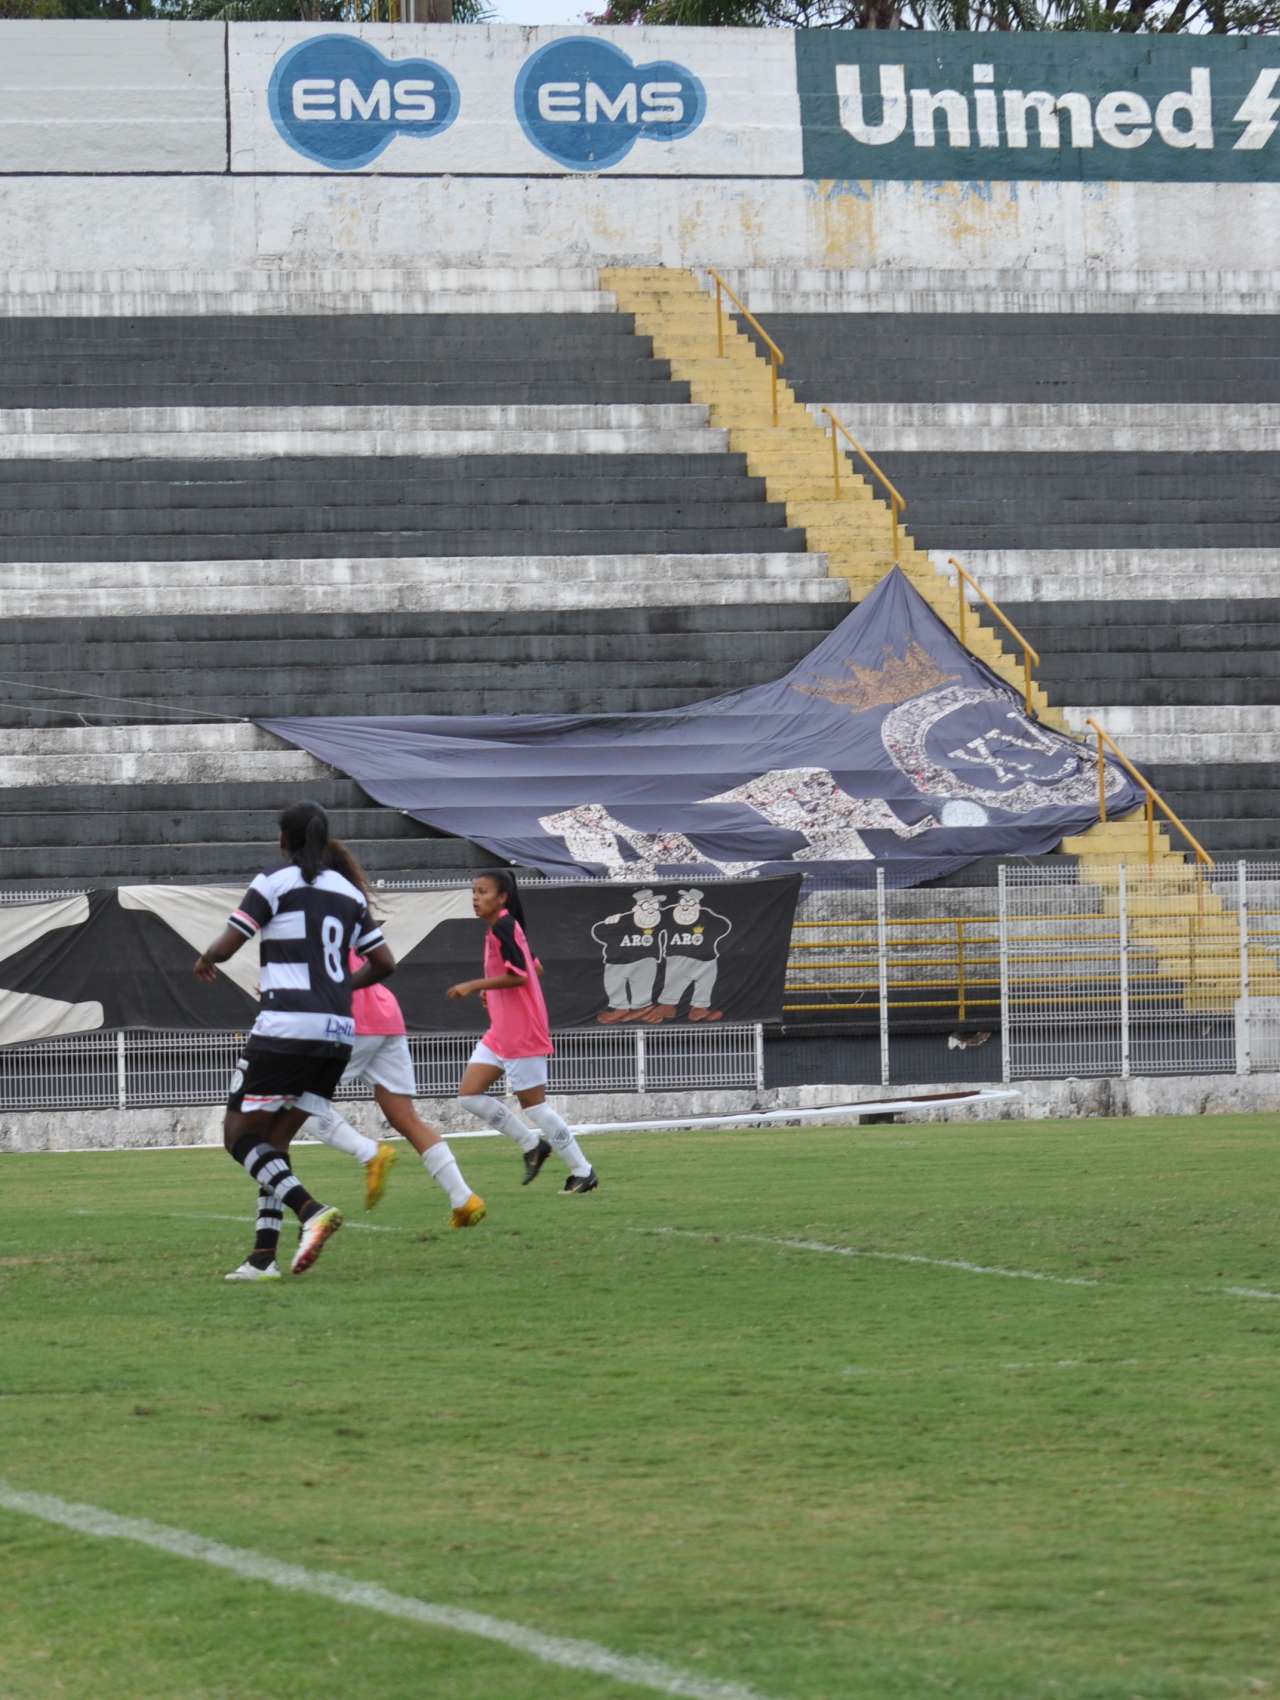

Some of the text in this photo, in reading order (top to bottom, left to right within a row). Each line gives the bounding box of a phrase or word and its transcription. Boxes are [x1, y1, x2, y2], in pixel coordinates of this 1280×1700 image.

[292, 79, 436, 121] EMS
[537, 81, 684, 124] EMS
[835, 64, 1215, 150] Unimed
[321, 915, 345, 983] 8
